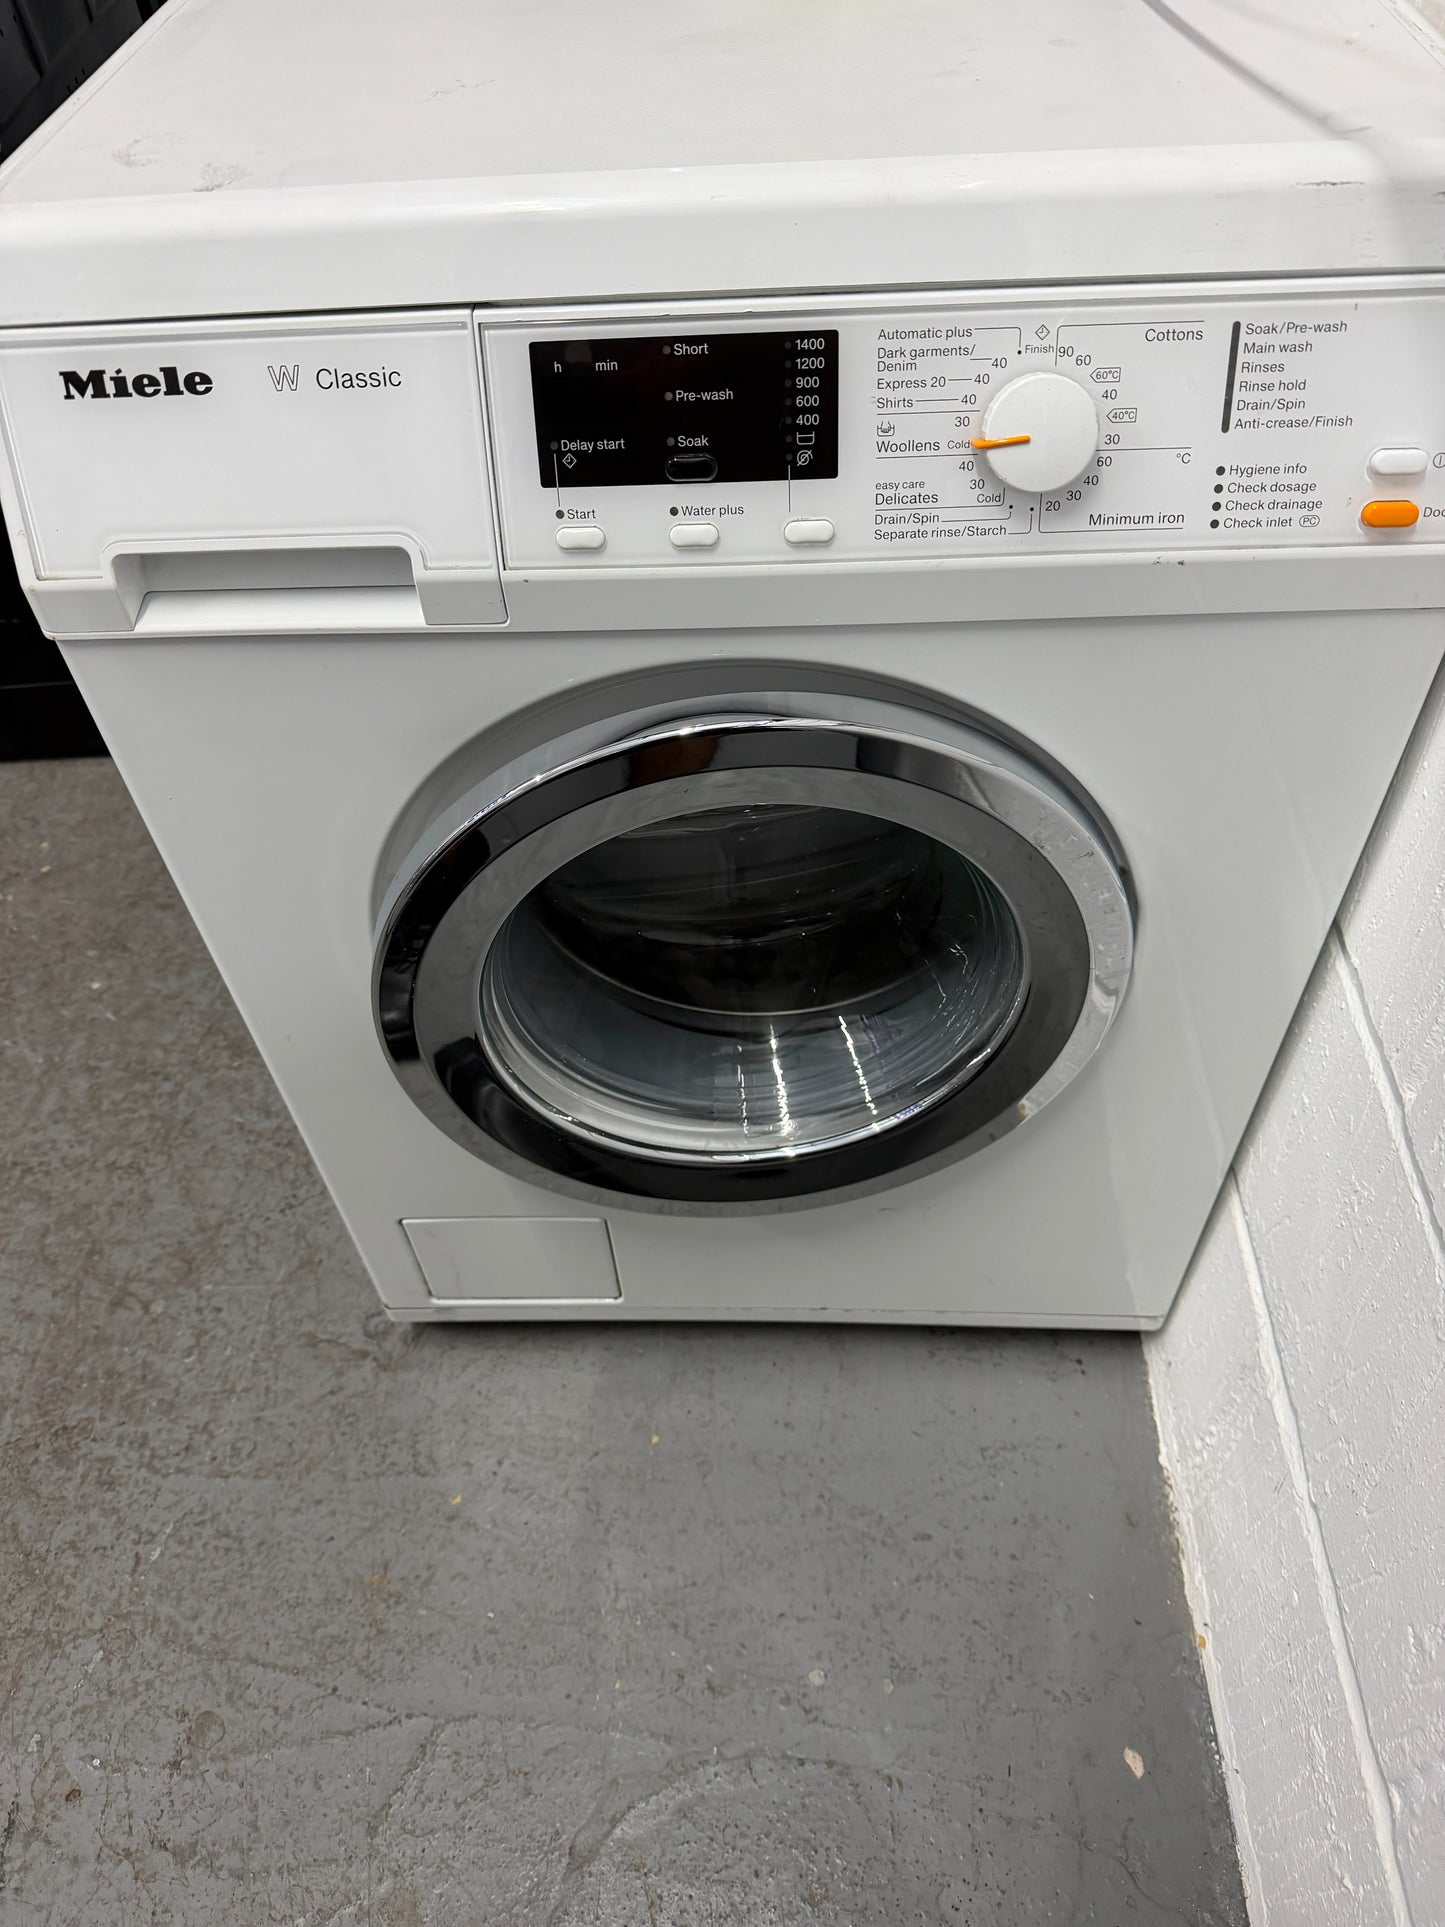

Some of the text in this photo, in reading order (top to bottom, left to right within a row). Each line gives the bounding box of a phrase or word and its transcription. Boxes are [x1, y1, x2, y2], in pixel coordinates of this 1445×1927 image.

[878, 327, 973, 340] Automatic plus
[1245, 321, 1348, 335] Soak/Pre-wash
[1145, 328, 1203, 342] Cottons
[674, 343, 709, 355] Short
[795, 339, 825, 350] 1400
[1025, 344, 1054, 354] Finish
[1243, 341, 1313, 354] Main wash
[877, 344, 976, 360] Dark garments/
[1059, 346, 1074, 358] 90
[554, 360, 618, 373] h min
[796, 358, 825, 370] 1200
[877, 361, 917, 372] Denim
[992, 357, 1008, 368] 40
[1075, 355, 1091, 366] 60
[1241, 362, 1285, 373] Rinses
[268, 364, 402, 391] W Classic
[974, 373, 990, 385] 40
[1095, 370, 1119, 380] 60°C
[59, 366, 214, 400] Miele
[796, 377, 819, 389] 900
[877, 376, 946, 392] Express 20
[1239, 380, 1306, 392] Rinse hold
[675, 389, 734, 402] Pre-wash
[961, 394, 977, 405] 40
[1102, 389, 1118, 400] 40
[796, 396, 819, 407] 600
[877, 397, 913, 408] Shirts
[1236, 399, 1306, 412] Drain/Spin
[796, 415, 819, 426] 400
[1112, 410, 1135, 421] 40°C
[954, 416, 970, 428] 30
[1234, 416, 1353, 430] Anti-crease/Finish
[678, 436, 709, 447] Soak
[947, 439, 970, 449] Cold
[1104, 433, 1120, 445] 30
[561, 438, 625, 453] Delay start
[876, 439, 940, 453] Woollens
[1097, 456, 1112, 467] 60
[1176, 452, 1191, 464] °C
[958, 460, 974, 472] 40
[1229, 463, 1307, 477] Hygiene info
[875, 480, 925, 492] easy care
[969, 479, 985, 490] 30
[1083, 475, 1099, 486] 40
[1227, 481, 1316, 494] Check dosage
[875, 492, 938, 505] Delicates
[976, 493, 1001, 503] Cold
[1066, 490, 1082, 501] 30
[681, 504, 744, 517] Water plus
[1045, 500, 1061, 511] 20
[1225, 499, 1323, 511] Check drainage
[567, 509, 596, 519] Start
[874, 512, 940, 527] Drain/Spin
[1089, 513, 1185, 526] Minimum iron
[1223, 518, 1263, 528] Check
[1266, 516, 1292, 527] inlet
[874, 525, 1007, 542] Separate rinse/Starch
